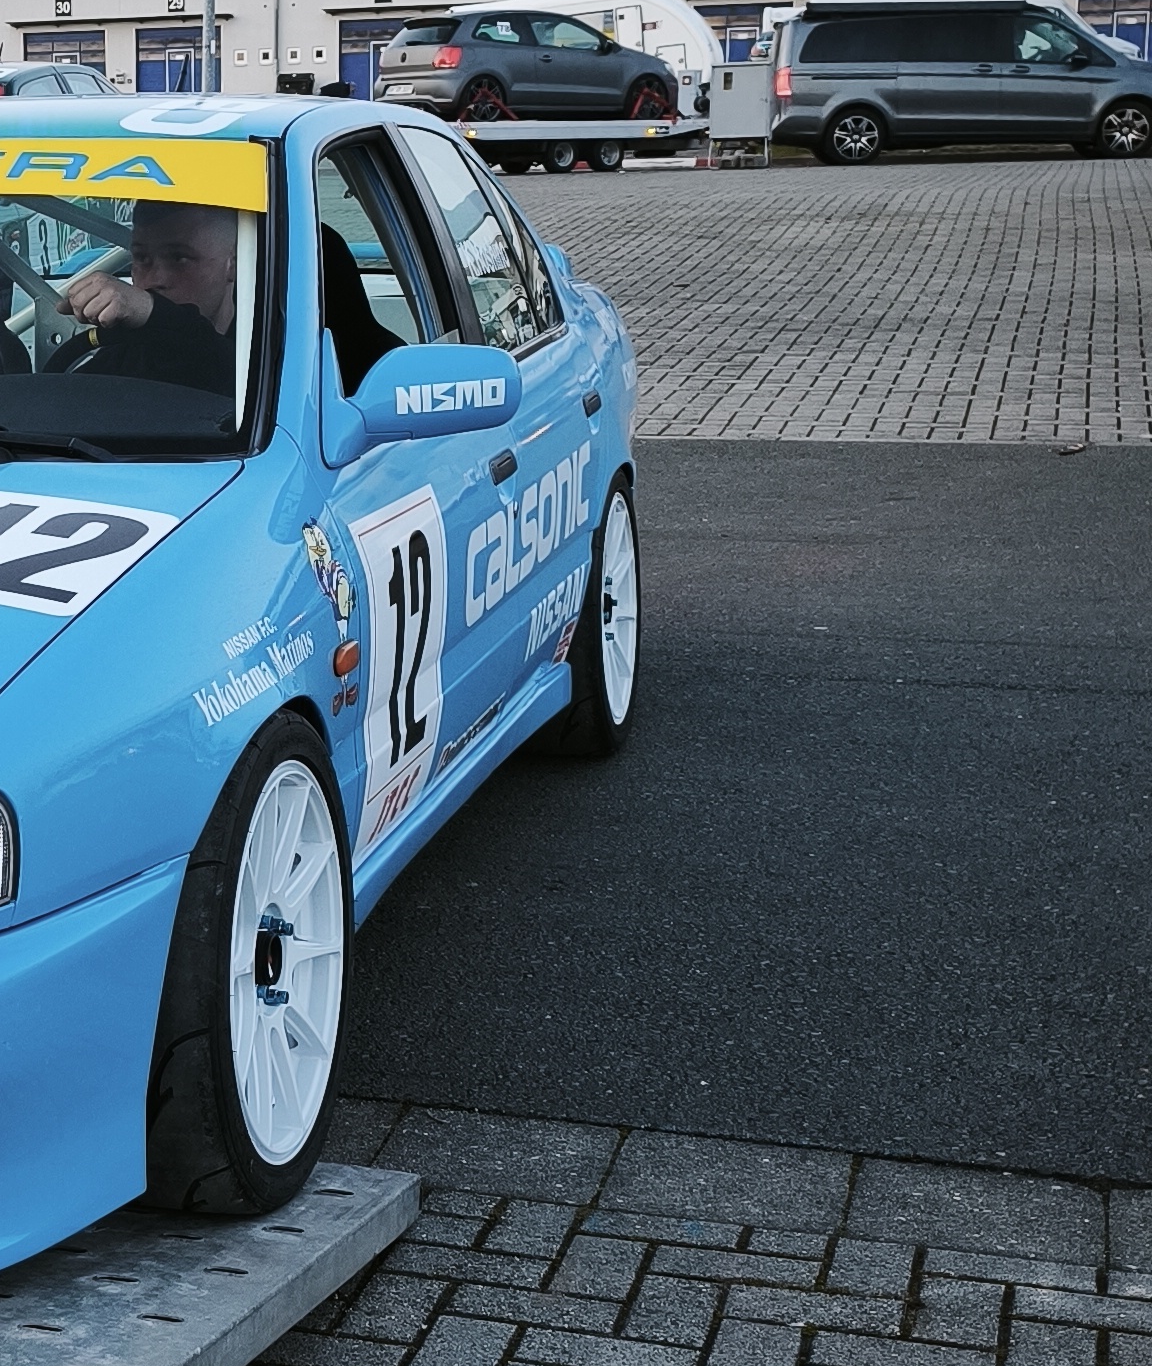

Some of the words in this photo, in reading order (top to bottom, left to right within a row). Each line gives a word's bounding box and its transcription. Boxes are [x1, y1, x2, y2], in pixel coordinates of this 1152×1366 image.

[56, 1, 71, 14] 30
[395, 378, 506, 415] NISMO
[222, 624, 263, 660] NISSAN
[257, 616, 278, 639] F.C.
[524, 563, 586, 663] NISSAN
[192, 661, 279, 727] Yokohama
[266, 630, 314, 679] Marinos
[389, 530, 431, 769] 12
